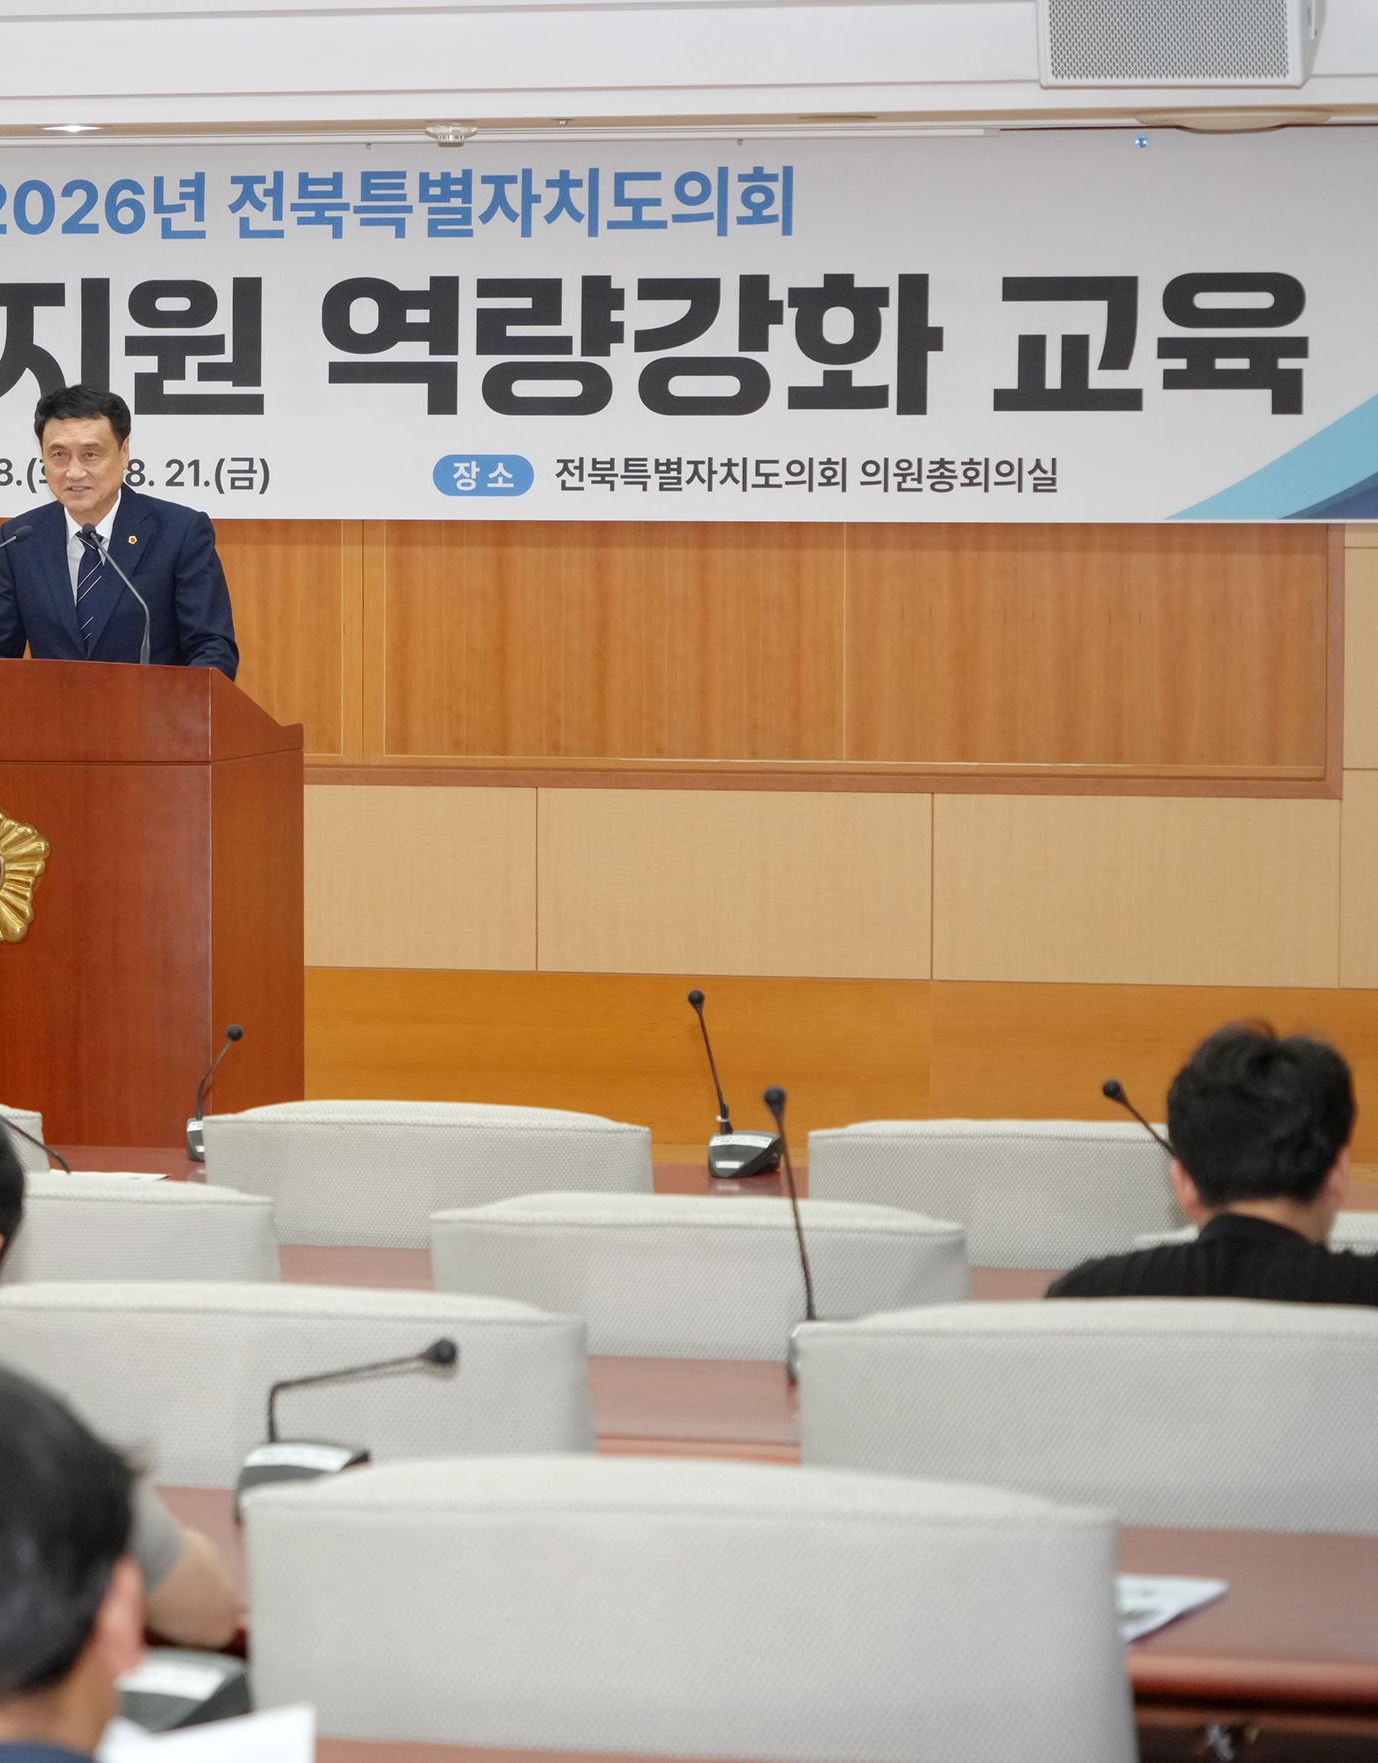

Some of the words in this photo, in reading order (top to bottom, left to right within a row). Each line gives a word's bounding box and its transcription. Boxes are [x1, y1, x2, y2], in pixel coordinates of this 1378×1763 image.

[228, 165, 794, 239] 전북특별자치도의회
[321, 273, 944, 416] 역량강화
[993, 272, 1309, 415] 교육
[165, 457, 270, 495] 21.(금)
[555, 456, 848, 493] 전북특별자치도의회
[859, 457, 1058, 493] 의원총회의실
